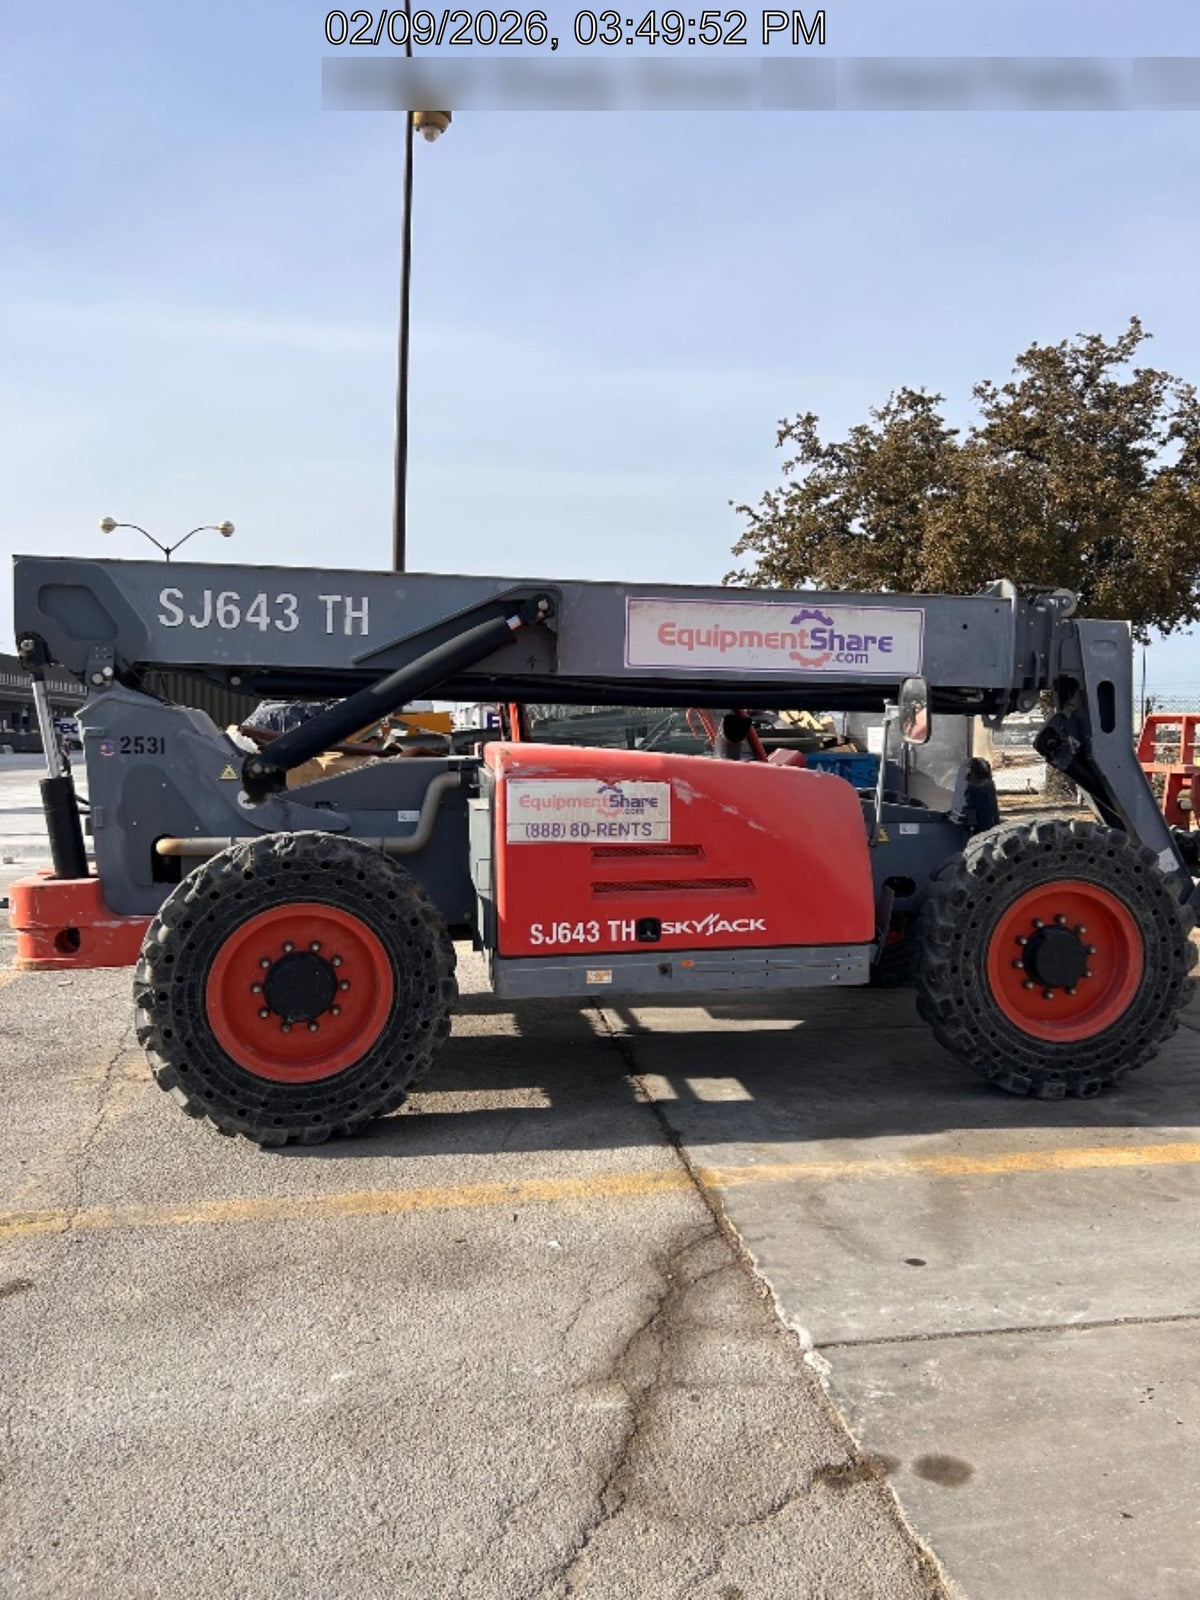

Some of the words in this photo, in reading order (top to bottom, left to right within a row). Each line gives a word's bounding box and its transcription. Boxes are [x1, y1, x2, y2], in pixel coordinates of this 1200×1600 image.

[157, 587, 300, 632] SJ643
[318, 594, 369, 636] TH
[657, 621, 894, 653] EquipmentShare
[831, 652, 869, 664] .com
[120, 735, 166, 755] 2531
[519, 793, 659, 811] EquipmentShare
[525, 822, 567, 839] (888)
[570, 821, 653, 838] 80-RENTS
[529, 920, 600, 945] SJ643
[607, 919, 636, 942] TH
[661, 913, 767, 936] SKYJACK
